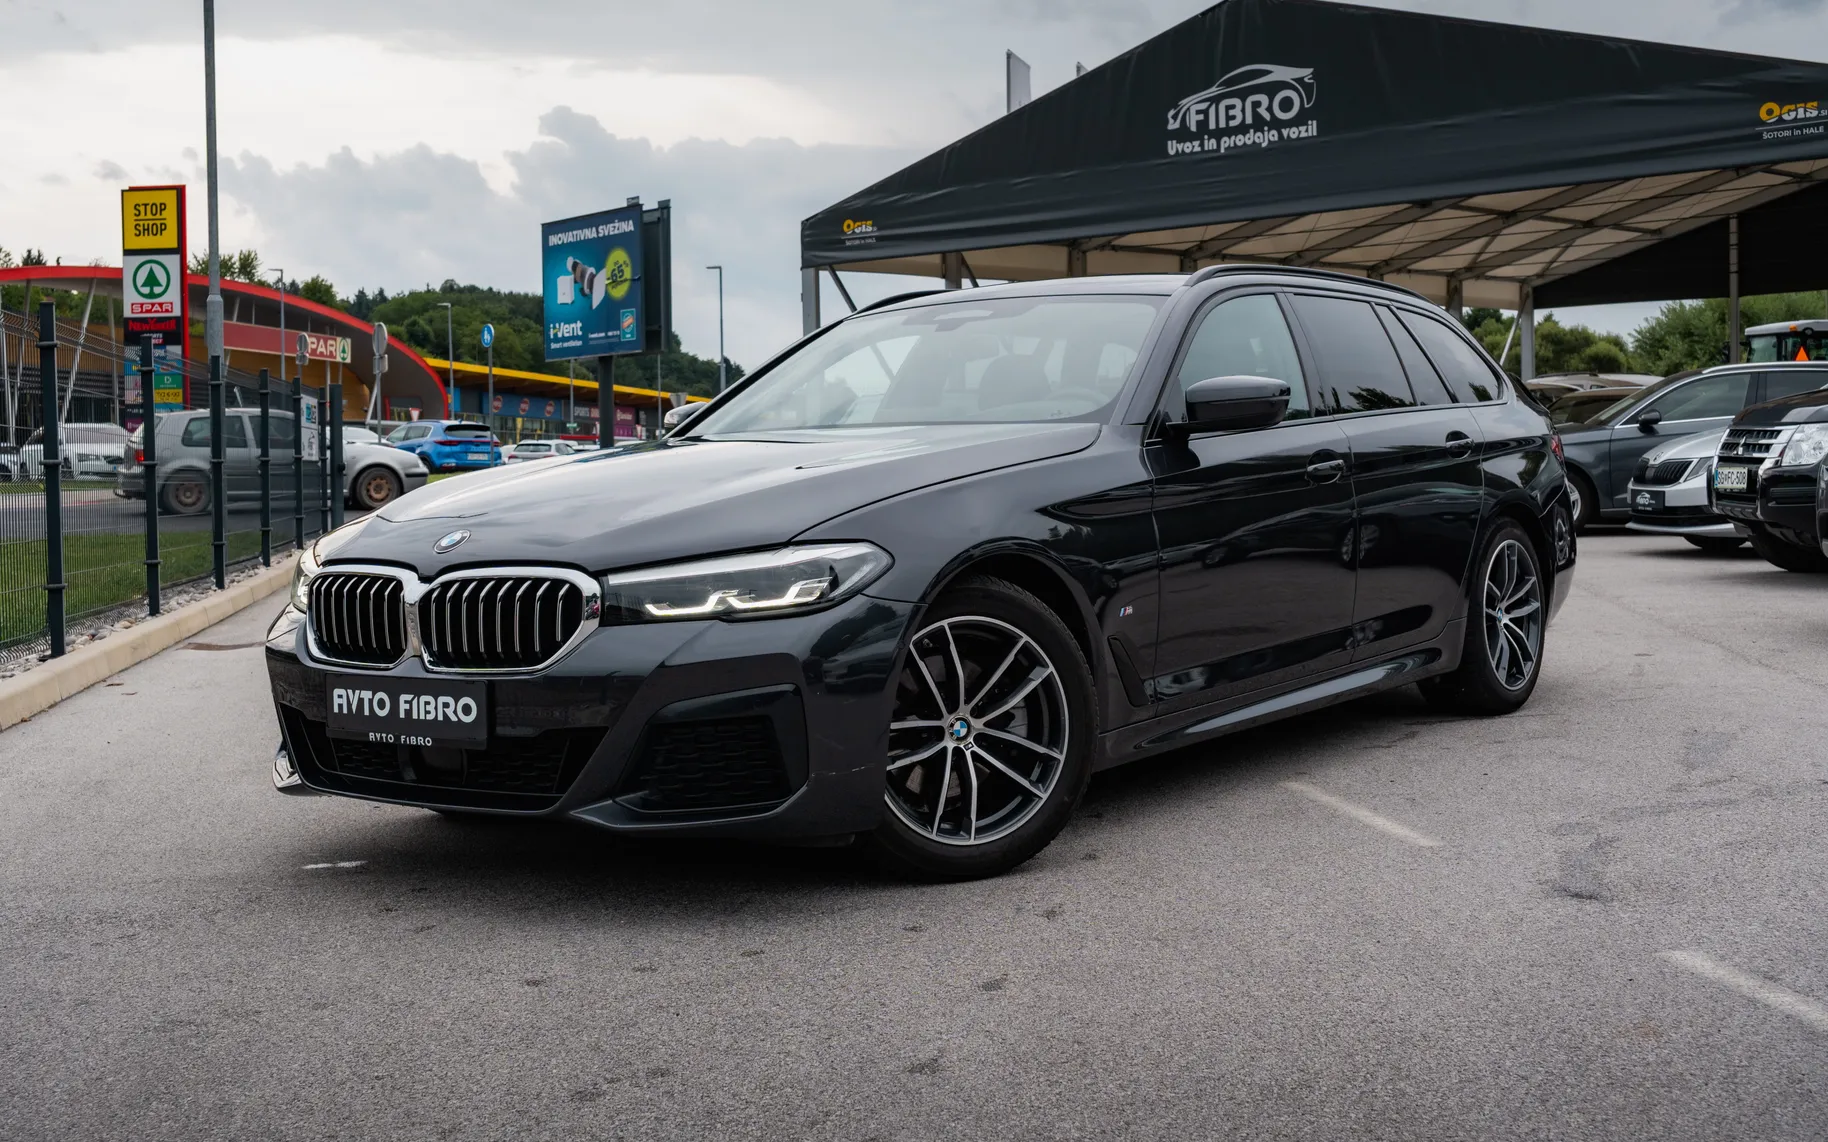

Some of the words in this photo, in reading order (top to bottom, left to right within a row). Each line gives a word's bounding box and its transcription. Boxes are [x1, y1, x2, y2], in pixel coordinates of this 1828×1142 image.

[1186, 89, 1300, 132] FIBRO
[1167, 140, 1201, 155] Uvoz
[1204, 135, 1217, 150] in
[1220, 126, 1278, 153] prodaja
[1281, 120, 1317, 139] vozil
[1763, 131, 1791, 139] ŠOTORI
[1803, 126, 1824, 134] HALE
[134, 203, 166, 217] STOP
[134, 222, 167, 237] SHOP
[549, 227, 597, 246] INOVATIVNA
[598, 219, 634, 237] SVEŽINA
[132, 303, 173, 313] SPAR
[309, 337, 336, 357] PAR
[400, 694, 477, 723] FIBRO
[400, 735, 432, 747] FIBRO
